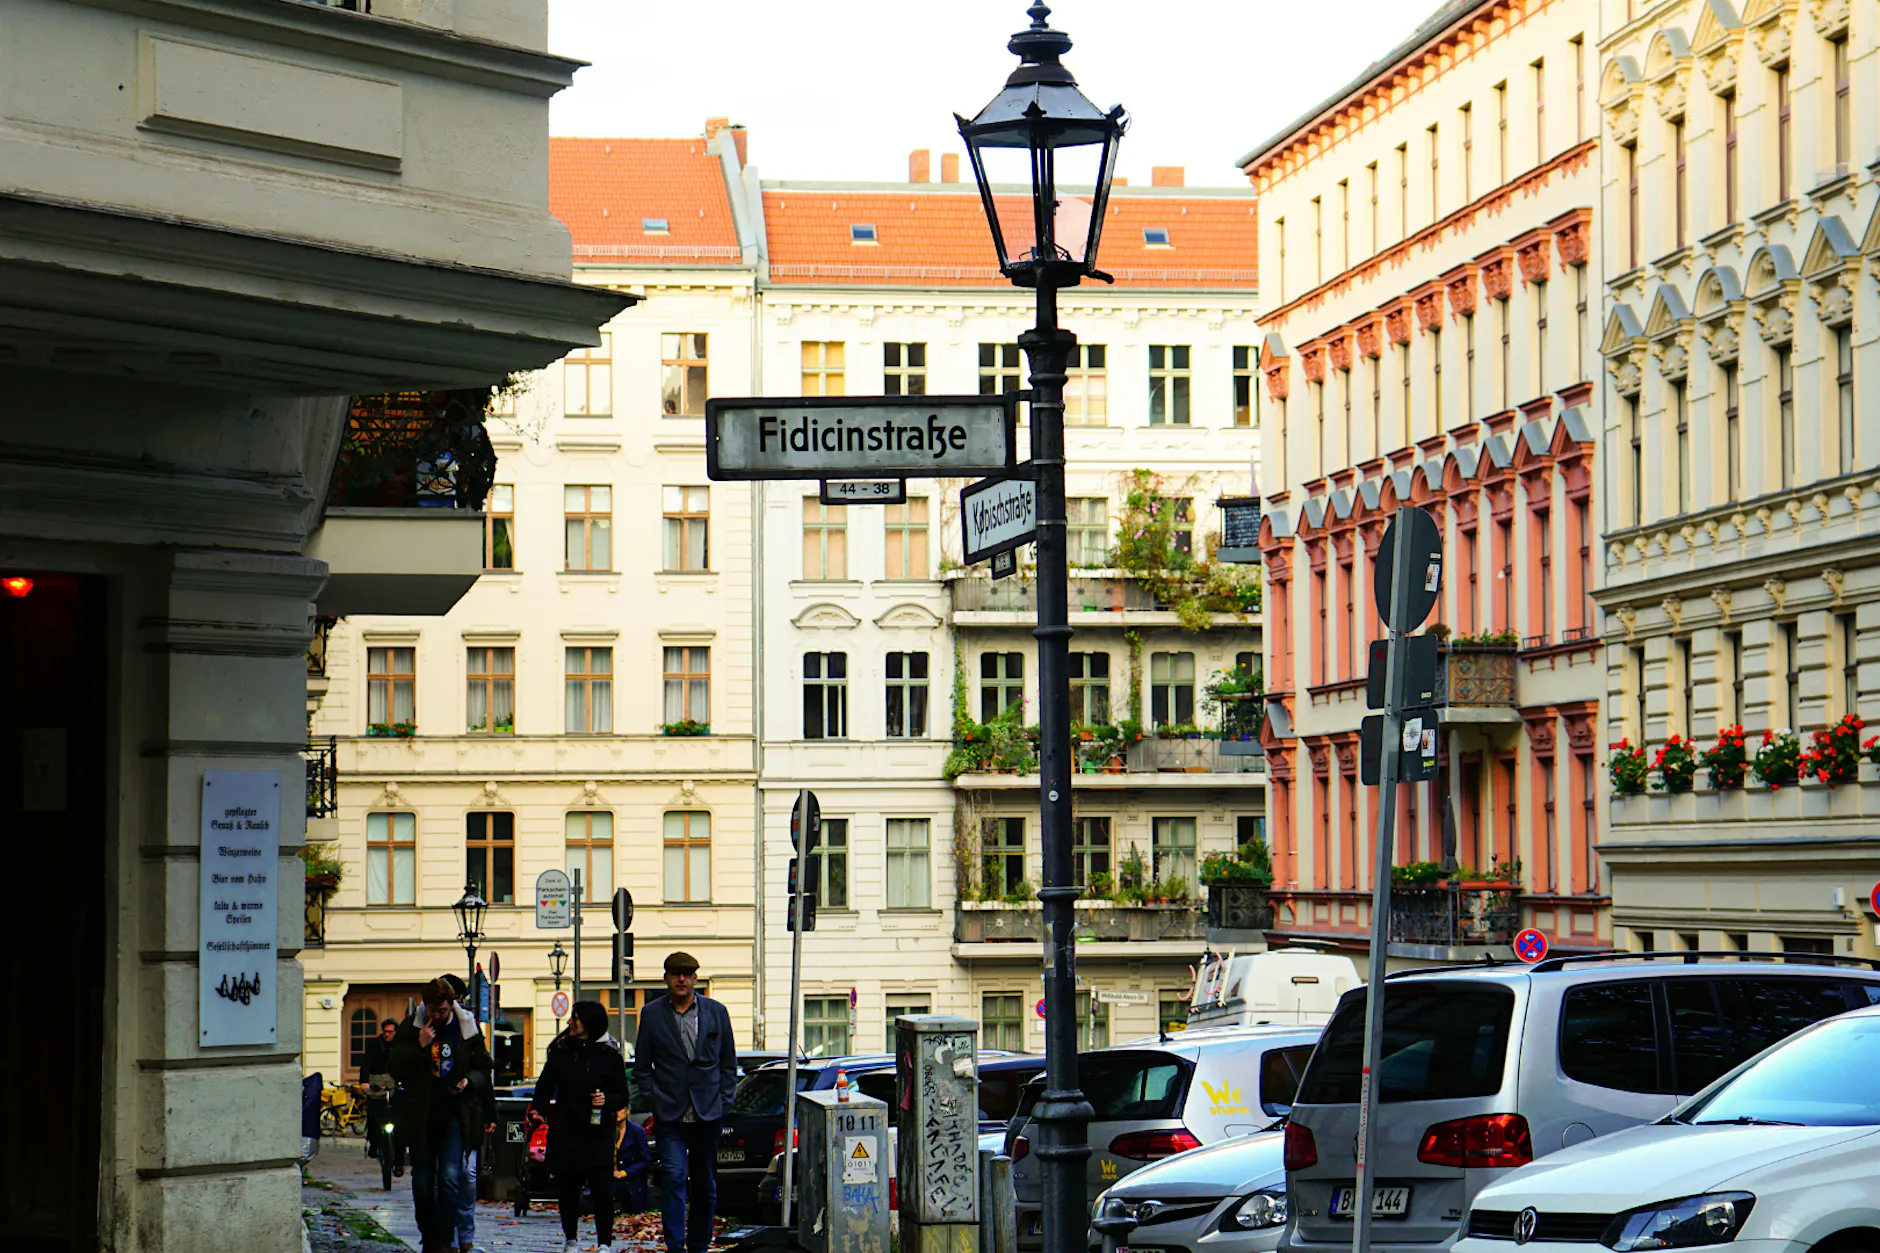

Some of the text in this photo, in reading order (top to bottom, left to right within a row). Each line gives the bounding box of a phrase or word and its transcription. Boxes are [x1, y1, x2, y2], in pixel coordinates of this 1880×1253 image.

[759, 414, 967, 459] Fidicinstraße
[840, 483, 856, 494] 44
[874, 483, 890, 494] 38
[236, 821, 242, 830] &
[1201, 1079, 1243, 1105] We
[1101, 1159, 1117, 1173] We
